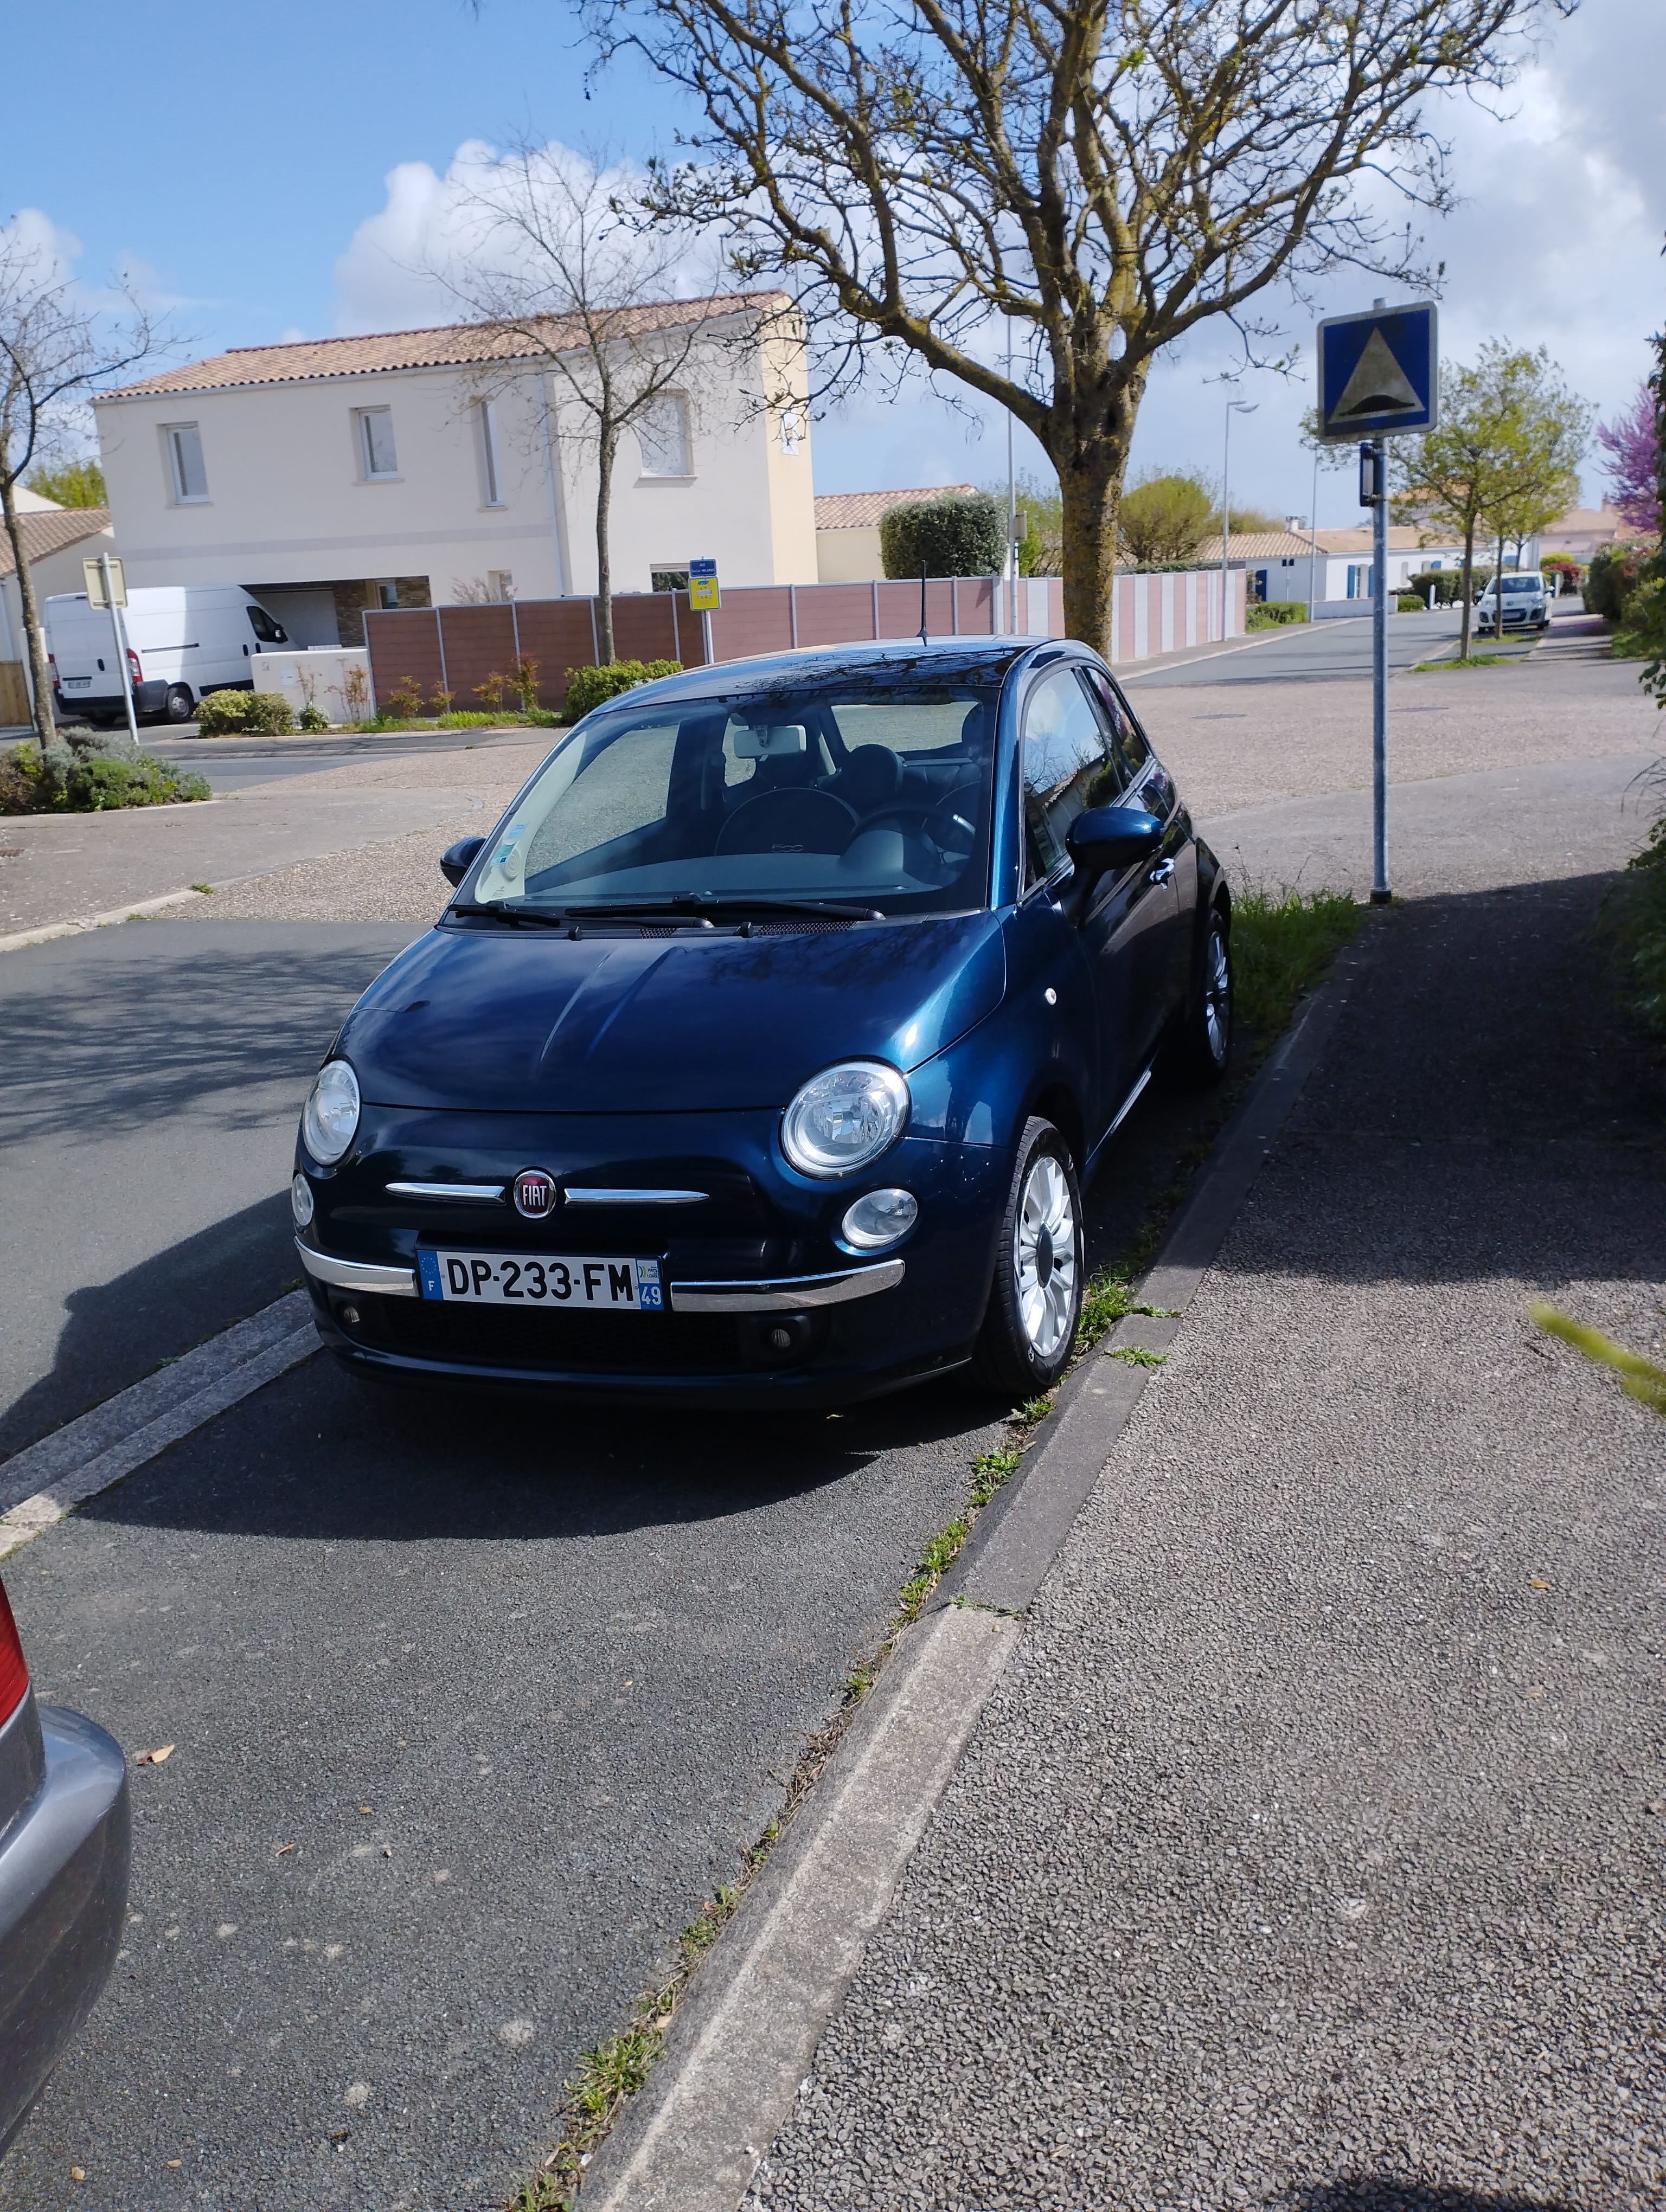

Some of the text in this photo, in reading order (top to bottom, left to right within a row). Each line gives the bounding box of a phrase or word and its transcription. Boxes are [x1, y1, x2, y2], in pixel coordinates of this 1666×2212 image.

[771, 844, 804, 852] 500
[522, 1185, 547, 1206] FIAT
[428, 1280, 435, 1291] F
[446, 1258, 634, 1302] DP-233-FM
[641, 1286, 662, 1305] 49
